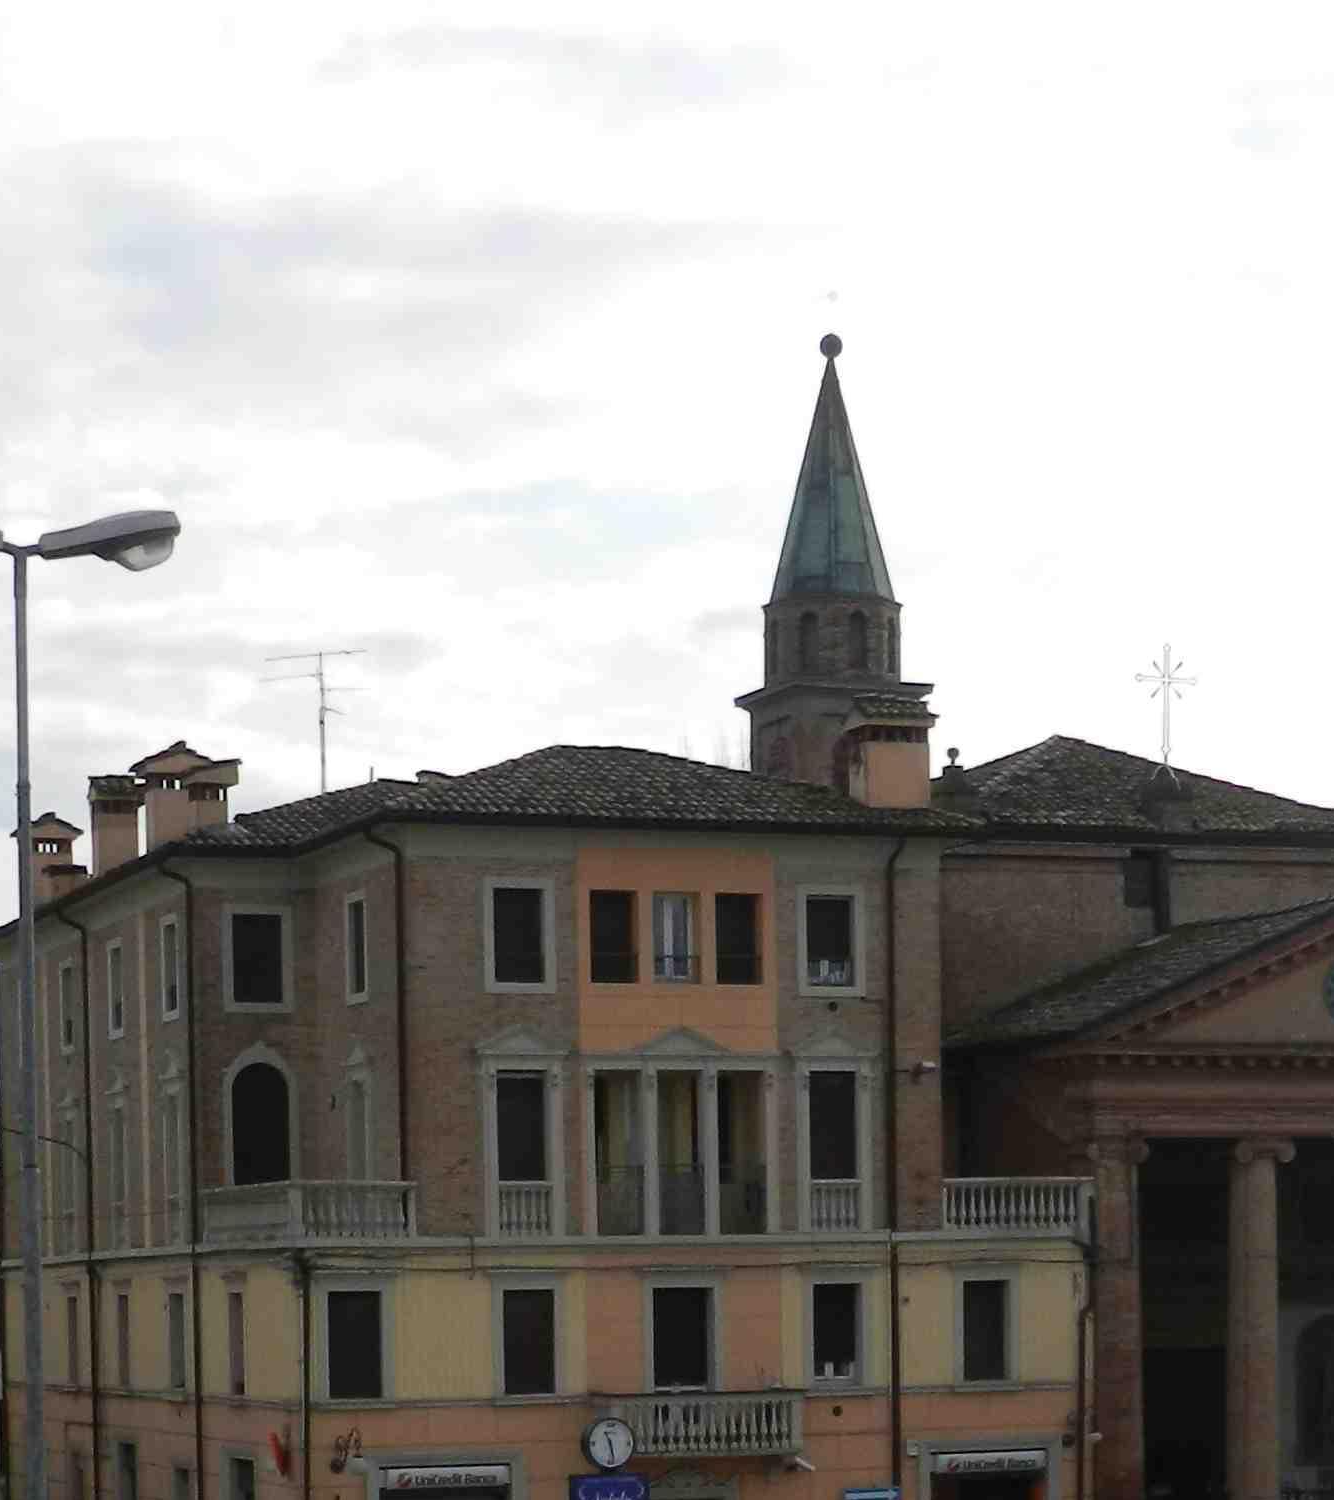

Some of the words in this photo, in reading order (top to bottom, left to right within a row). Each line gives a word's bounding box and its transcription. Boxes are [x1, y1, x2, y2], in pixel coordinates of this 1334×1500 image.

[963, 1458, 1006, 1471] UniCredit
[414, 1473, 462, 1486] UniCredit
[464, 1473, 497, 1485] Banca
